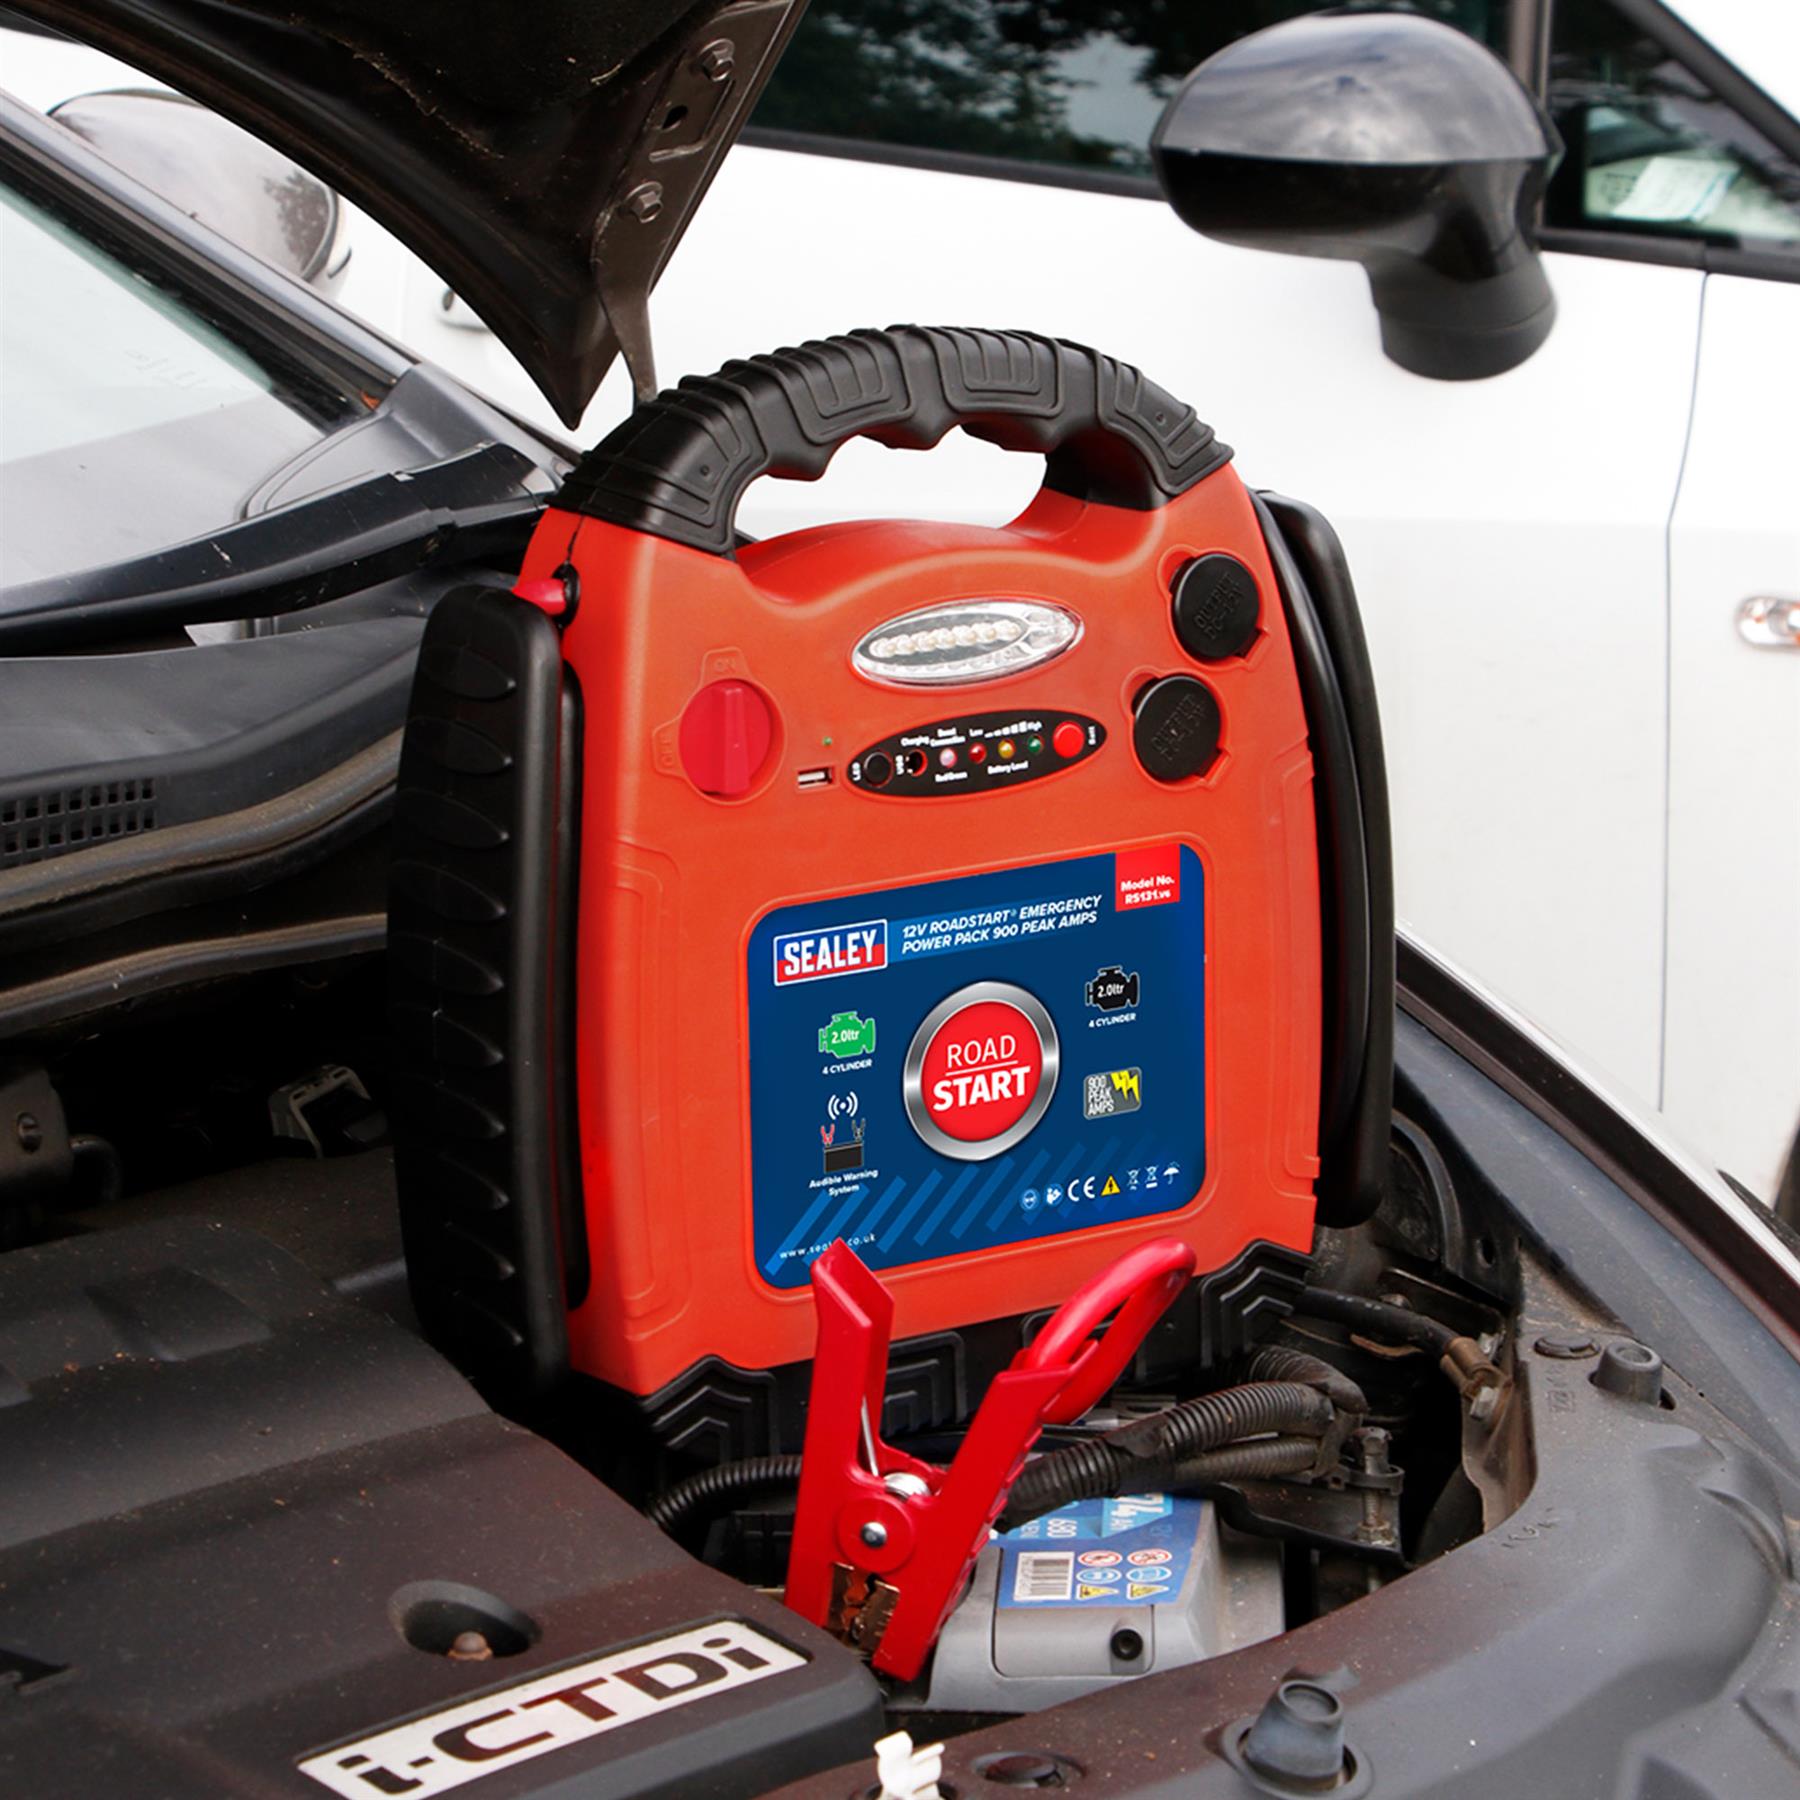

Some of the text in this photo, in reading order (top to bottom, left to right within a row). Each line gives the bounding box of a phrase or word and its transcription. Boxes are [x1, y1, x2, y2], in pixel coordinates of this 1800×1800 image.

[1120, 875, 1175, 892] Model No.
[902, 923, 928, 939] 12V
[1019, 894, 1102, 920] EMERGENCY
[901, 911, 1098, 955] POWER PACK 900 PEAK AMPS
[783, 929, 878, 976] SEALEY
[1088, 1012, 1137, 1028] 4 CYLINDER
[947, 1034, 1016, 1069] ROAD
[822, 1058, 873, 1075] 4 CYLINDER
[933, 1065, 1031, 1111] START
[1088, 1100, 1114, 1116] AMPS
[809, 1169, 879, 1189] Audible Warning
[828, 1184, 860, 1197] System
[337, 1637, 771, 1796] i-CTDi
